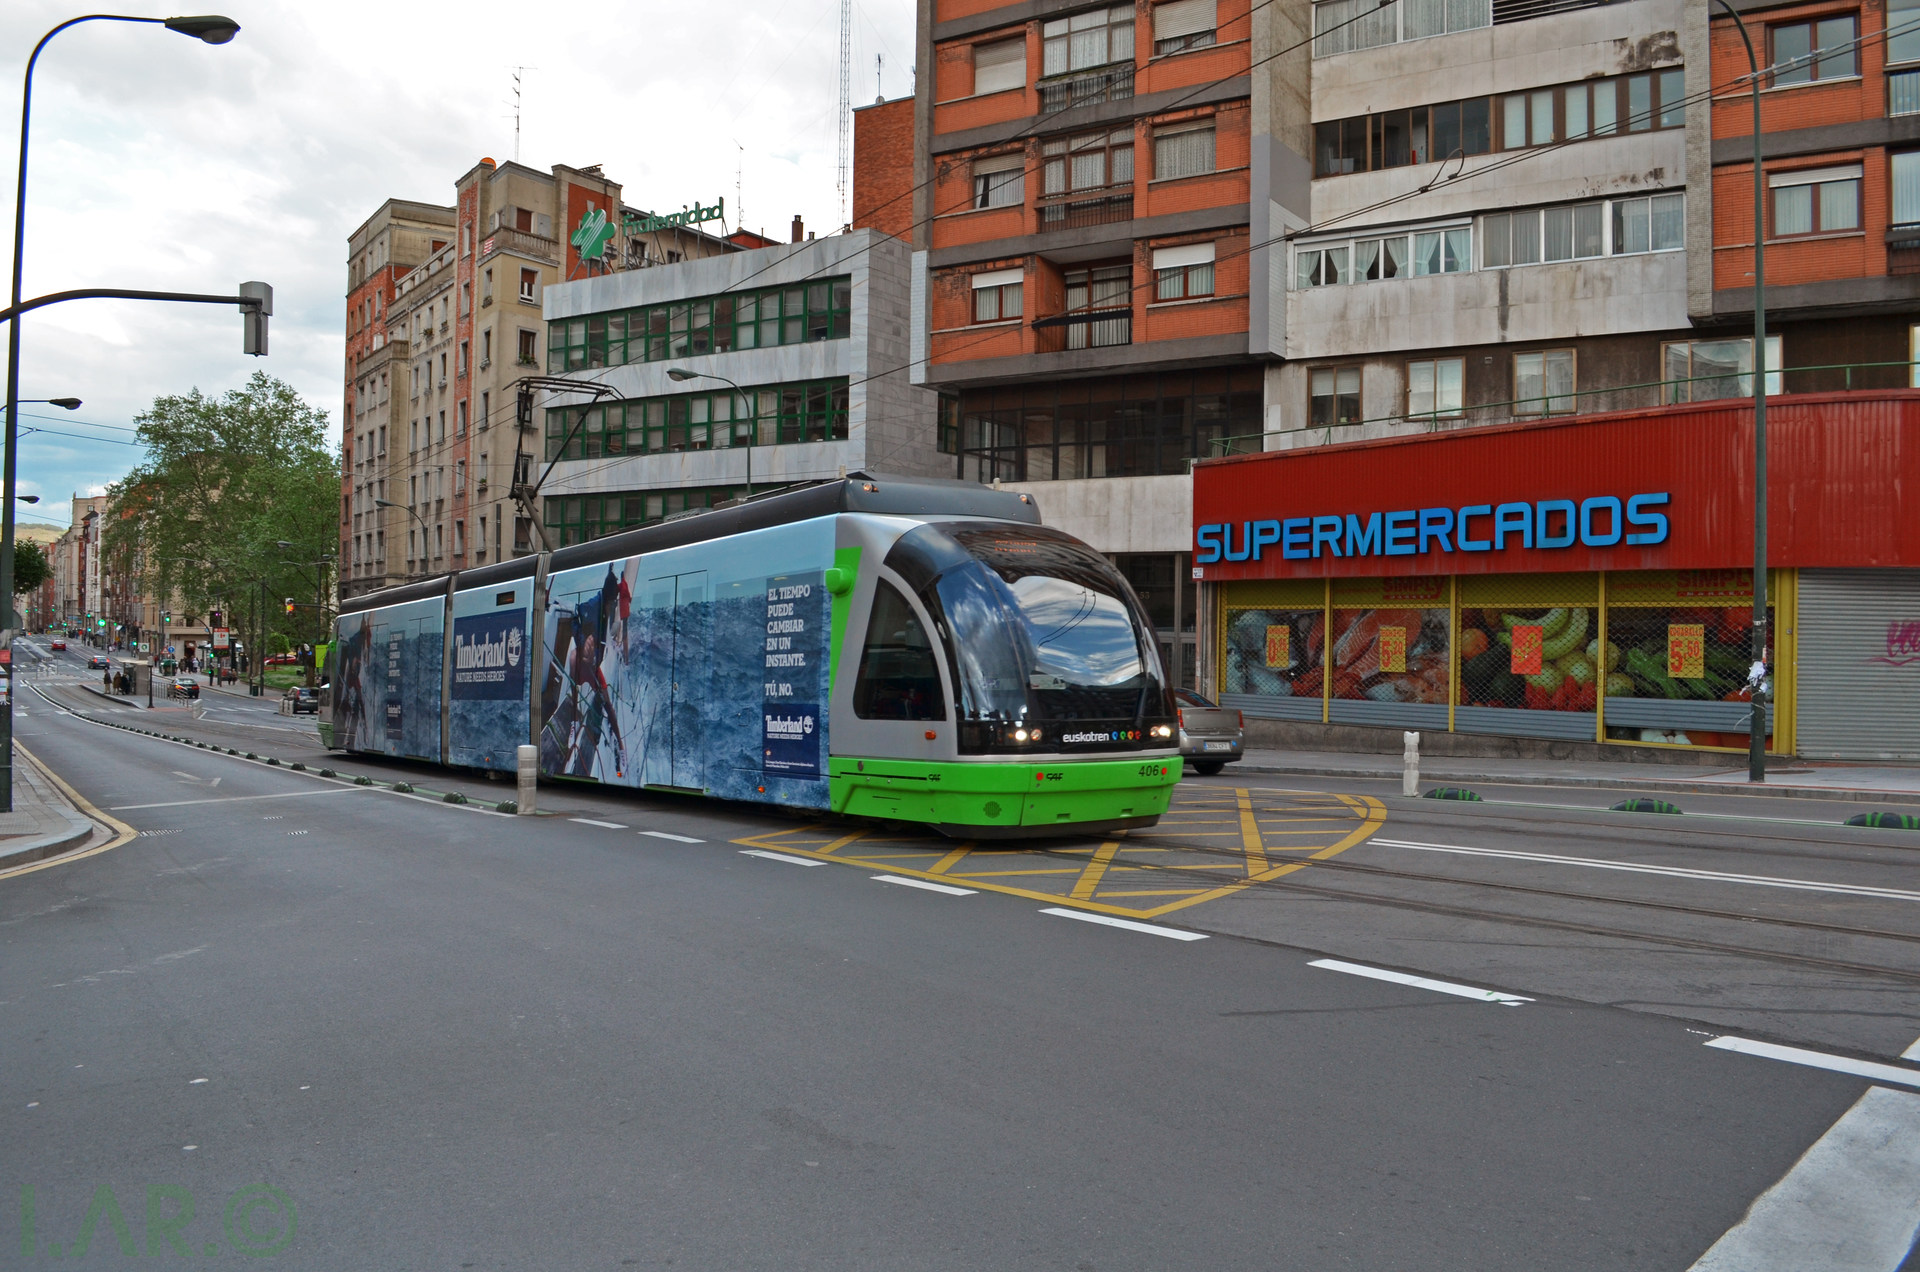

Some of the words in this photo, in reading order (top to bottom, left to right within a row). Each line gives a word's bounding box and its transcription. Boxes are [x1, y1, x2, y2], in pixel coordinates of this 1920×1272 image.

[623, 196, 724, 237] Fraternidad
[1196, 492, 1669, 563] SUPERMERCADOS
[768, 588, 778, 601] EL
[779, 584, 811, 600] TIEMPO
[767, 603, 794, 618] PUEDE
[767, 619, 804, 634] CAMBIAR
[455, 629, 507, 669] Timberland
[766, 637, 778, 651] EN
[778, 637, 792, 650] UN
[765, 653, 806, 668] INSTANTE.
[1670, 639, 1701, 673] 5,50
[455, 672, 473, 683] NATURE
[473, 671, 487, 682] NEEDS
[764, 680, 778, 698] TÚ,
[778, 683, 793, 697] NO.
[765, 714, 803, 733] Timberland
[1062, 731, 1110, 743] euskotren
[1046, 773, 1064, 781] CAF
[1138, 765, 1159, 777] 406
